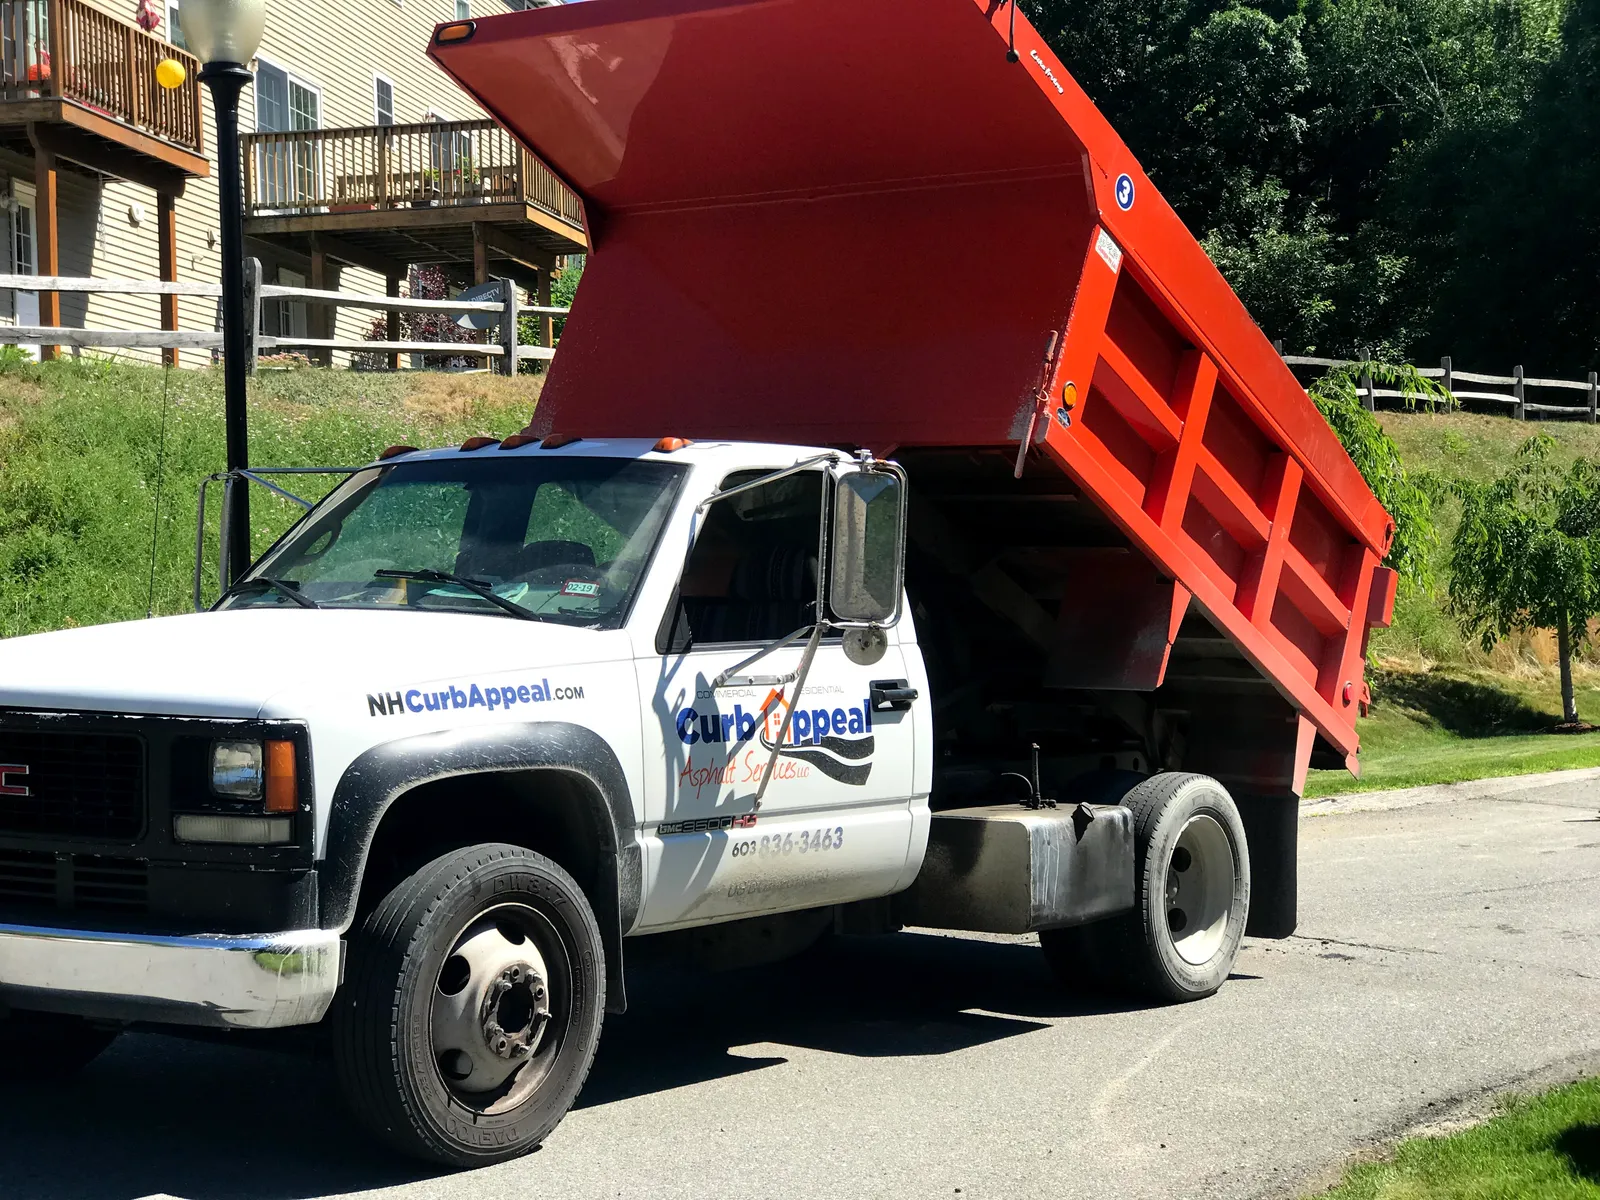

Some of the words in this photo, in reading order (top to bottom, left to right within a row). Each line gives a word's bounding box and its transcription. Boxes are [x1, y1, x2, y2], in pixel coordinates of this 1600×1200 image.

[1118, 180, 1131, 204] 3
[697, 688, 756, 699] COMMERCIAL
[795, 685, 844, 695] ESIDENTIAL
[676, 704, 756, 745] Curb
[679, 752, 736, 799] Asphalt
[741, 750, 797, 783] Serices
[732, 840, 756, 857] 603
[758, 826, 843, 860] 836-3463
